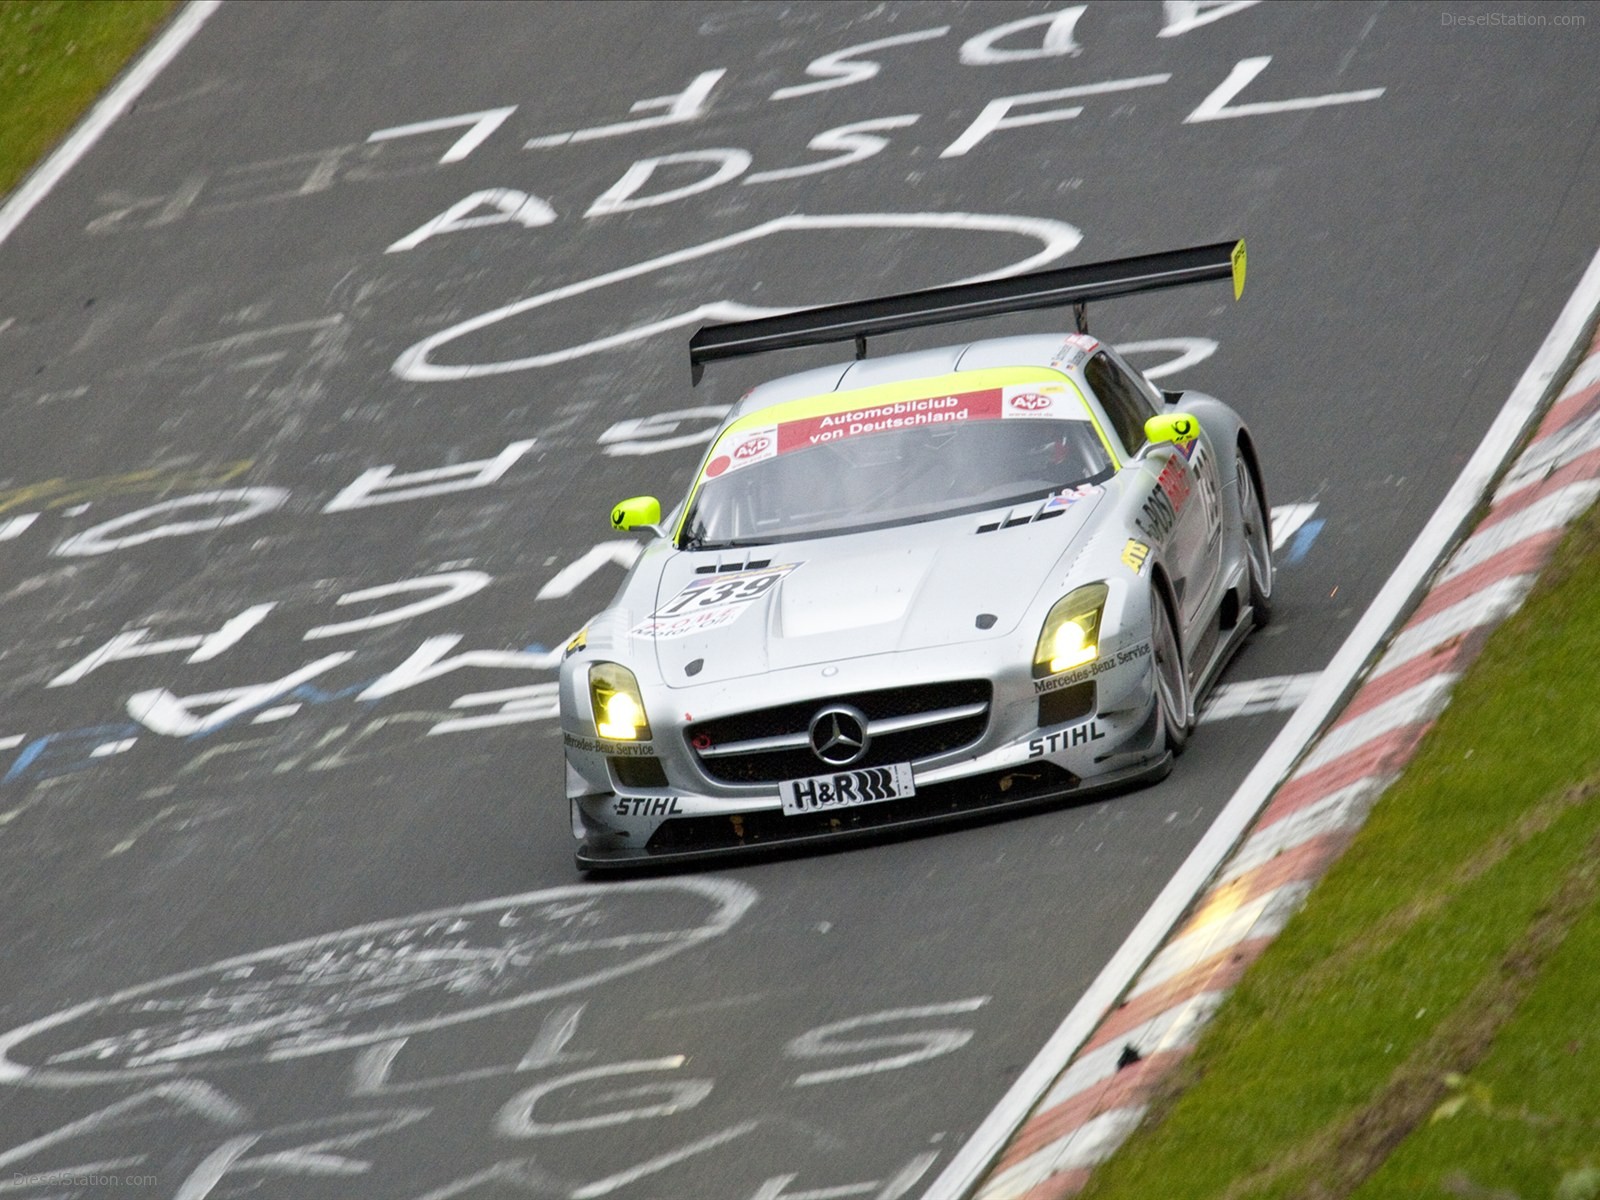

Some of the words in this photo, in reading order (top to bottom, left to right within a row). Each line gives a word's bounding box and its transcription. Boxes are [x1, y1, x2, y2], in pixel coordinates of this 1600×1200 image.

[386, 55, 1388, 254] ADSFL
[808, 428, 845, 445] von
[849, 407, 970, 436] Deutschland
[818, 396, 960, 429] Automobilclub
[666, 573, 783, 614] 739
[1032, 658, 1117, 694] Mercedes-Benz
[1116, 642, 1151, 665] Service
[563, 732, 615, 754] Mercedes-Benz
[615, 743, 655, 756] Service
[1028, 721, 1106, 759] STIHL
[615, 796, 683, 817] STIHL
[792, 767, 861, 809] H&R
